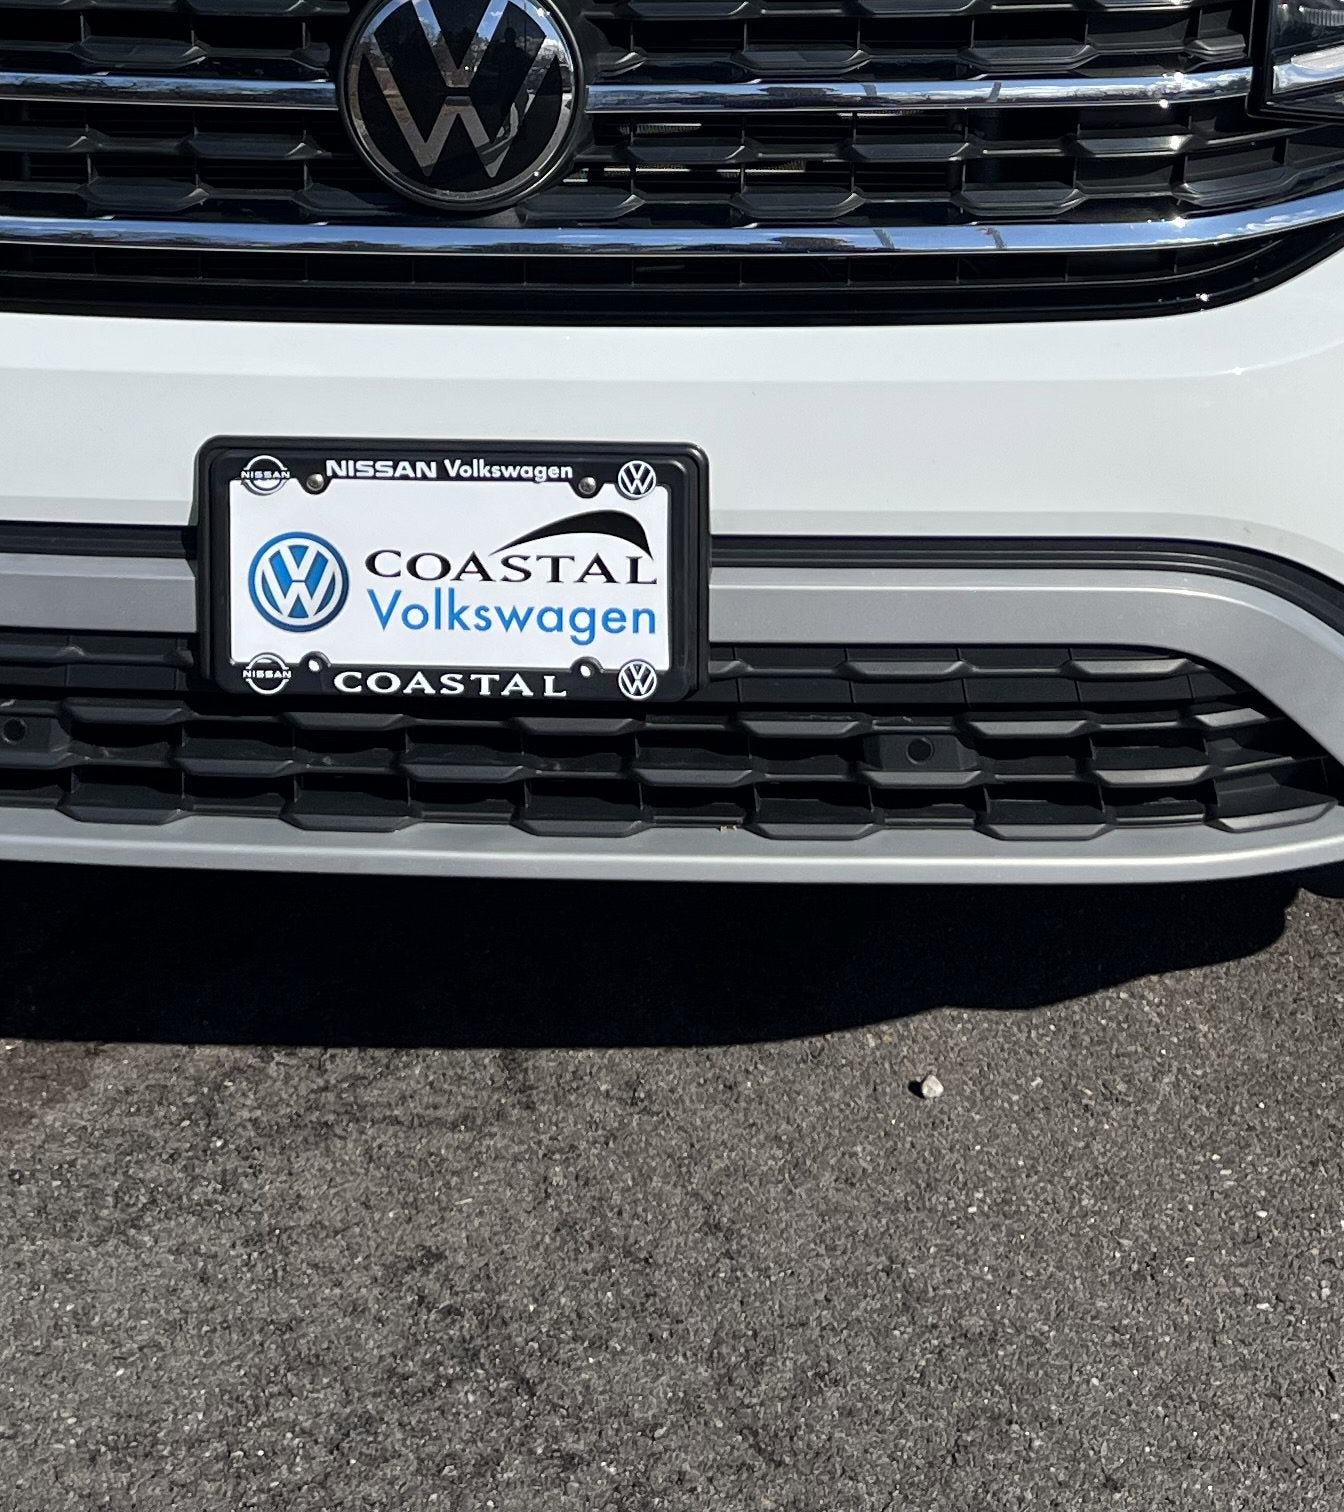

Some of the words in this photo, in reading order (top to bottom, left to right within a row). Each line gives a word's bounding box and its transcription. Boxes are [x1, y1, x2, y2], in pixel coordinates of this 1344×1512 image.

[325, 459, 437, 479] NISSAN
[443, 459, 573, 484] Volkswagen
[364, 549, 657, 585] COASTAL
[366, 587, 656, 646] Volkswagen
[333, 670, 567, 697] COASTAL
